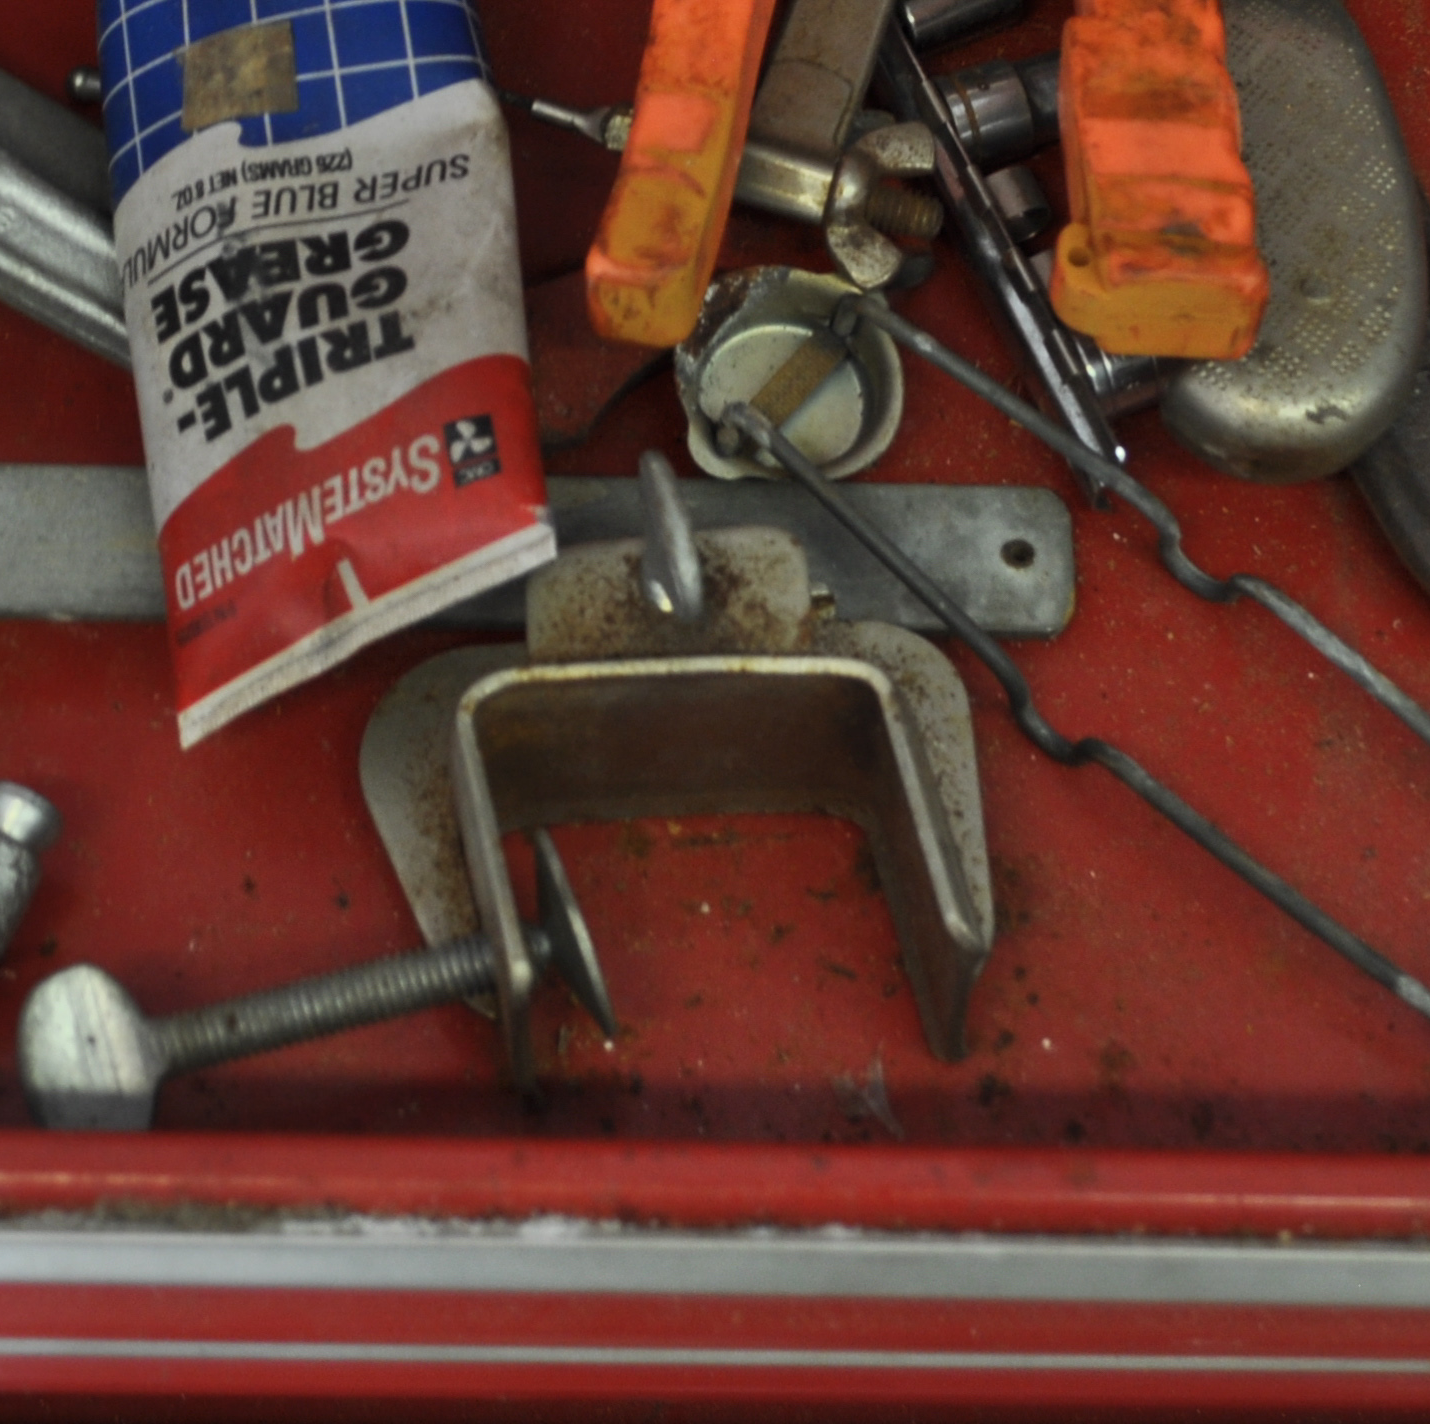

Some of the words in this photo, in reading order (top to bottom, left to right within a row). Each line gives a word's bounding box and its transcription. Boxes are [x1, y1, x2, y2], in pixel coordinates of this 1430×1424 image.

[208, 169, 239, 194] NET
[242, 156, 313, 183] GRAMS)
[353, 153, 470, 205] SUPER
[252, 181, 339, 220] BLUE
[120, 194, 237, 291] FORMUL
[150, 218, 411, 344] GREASE
[176, 309, 415, 443] TRIPLE-
